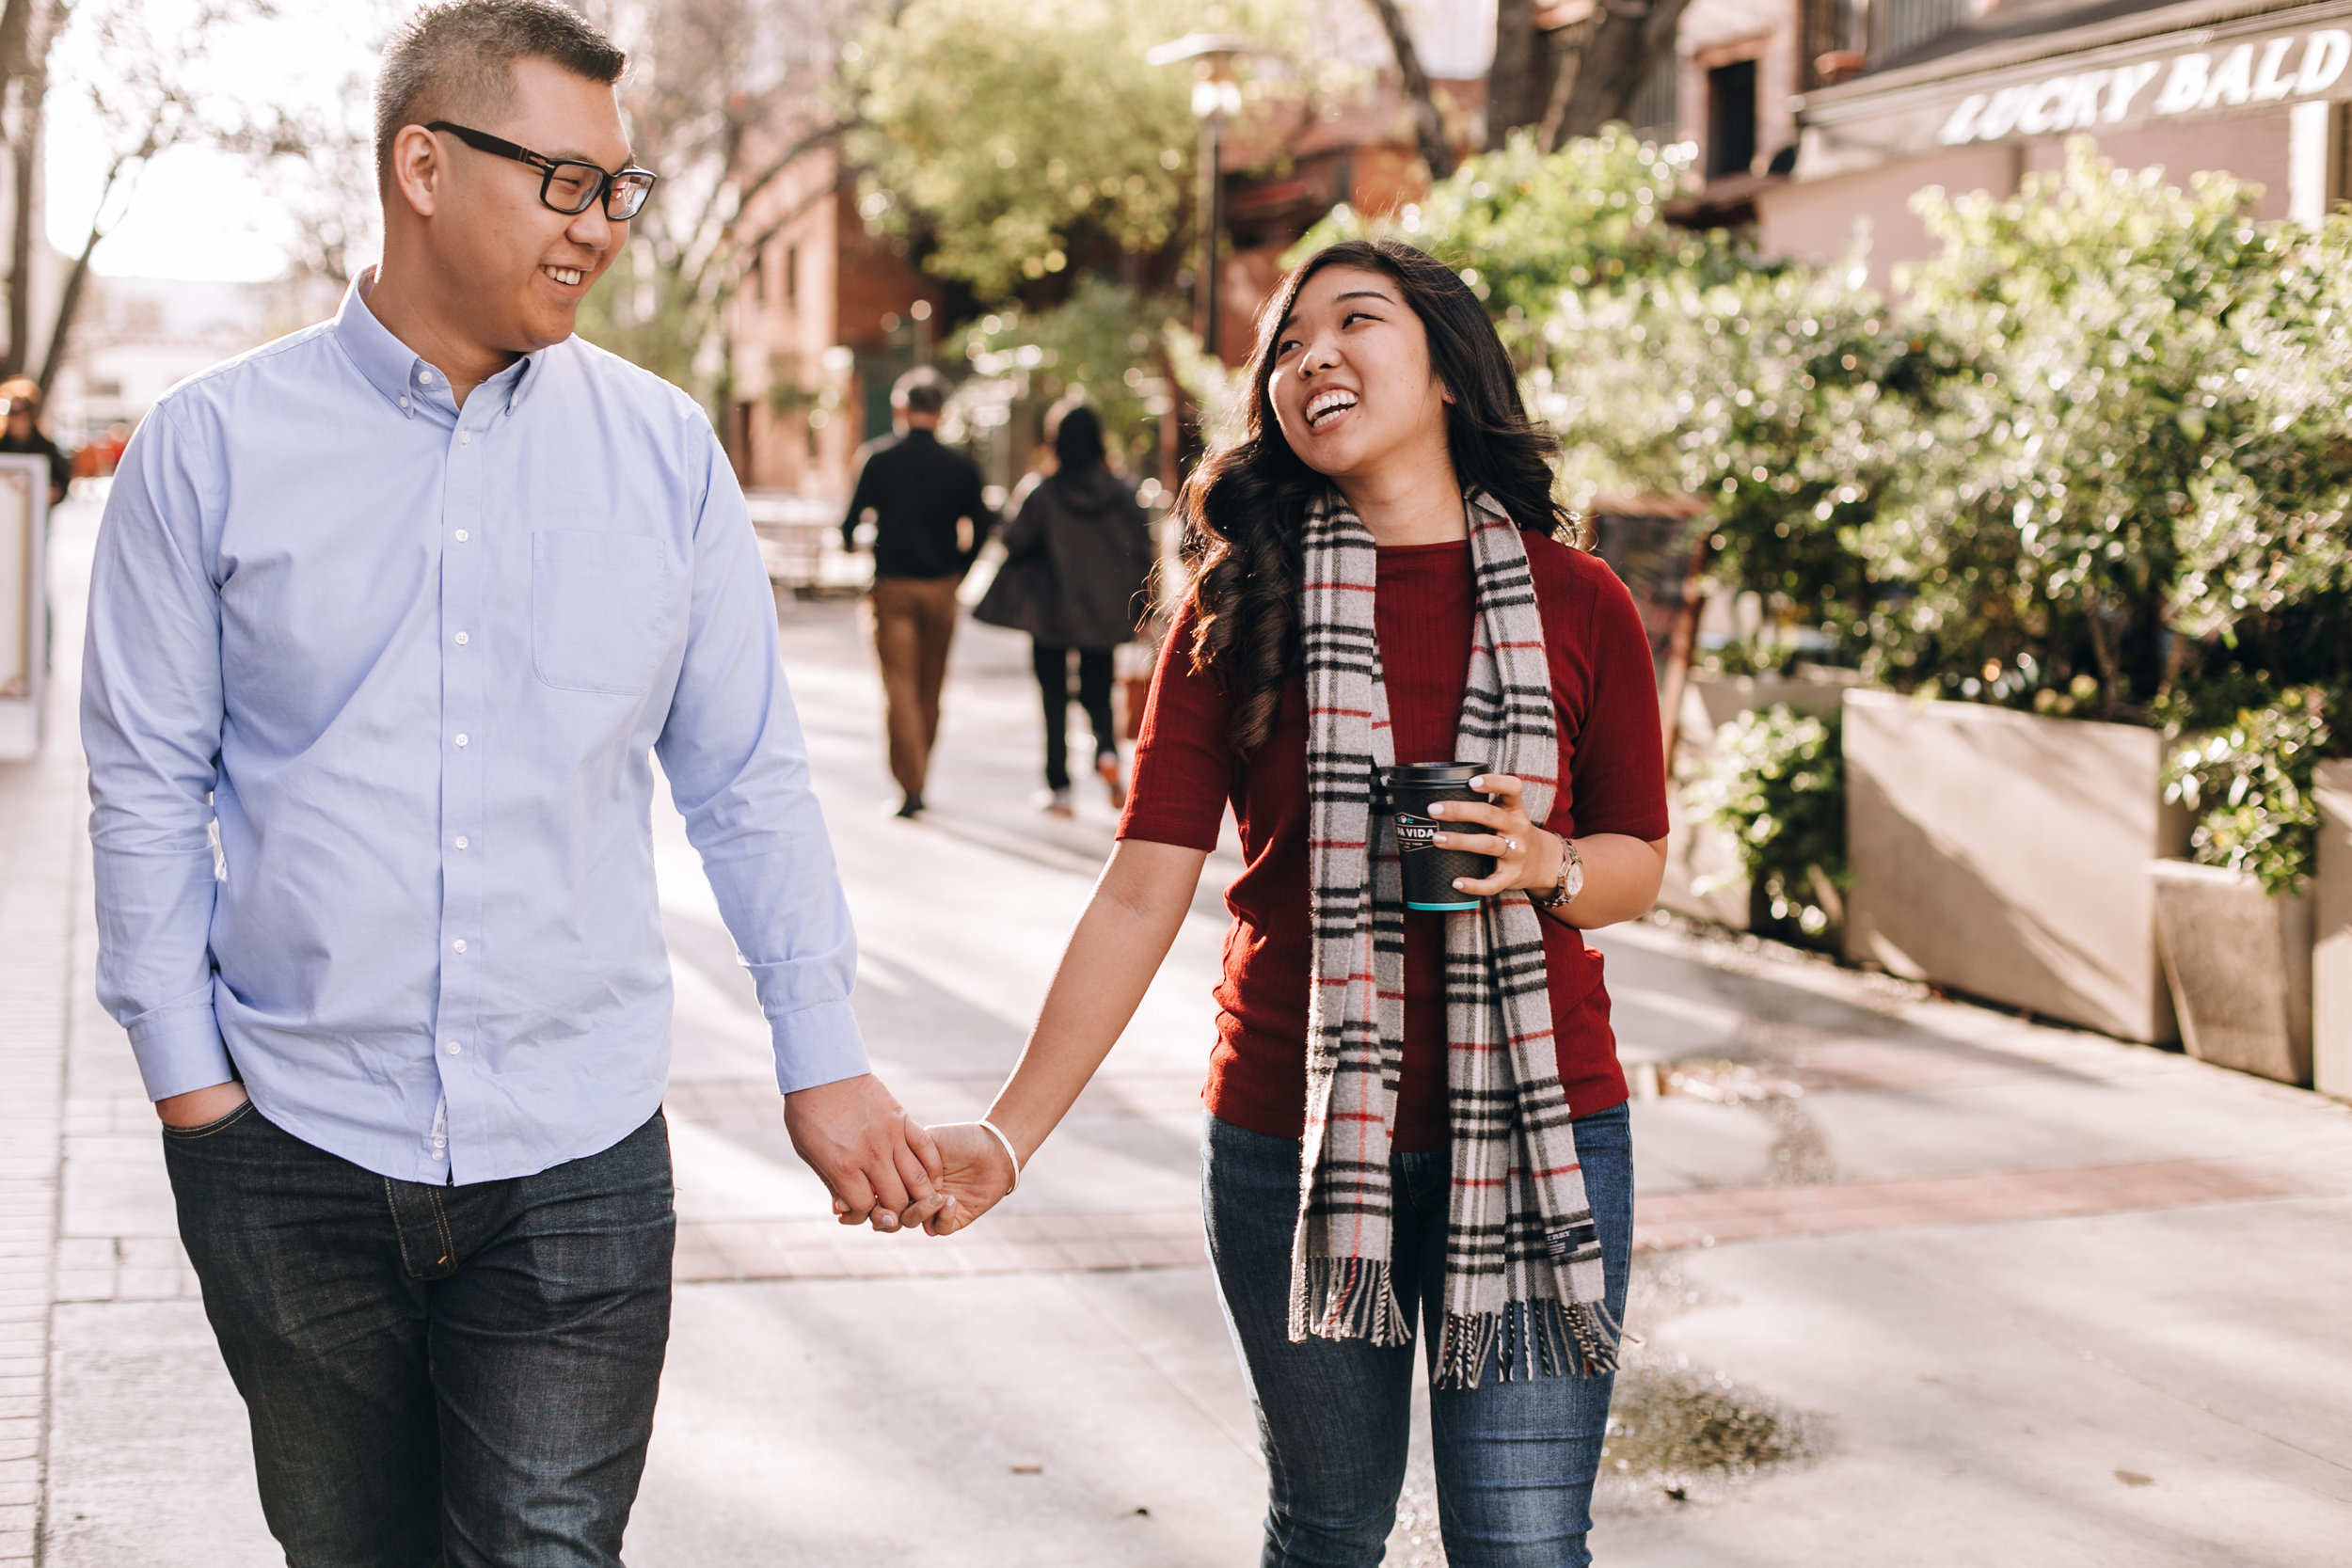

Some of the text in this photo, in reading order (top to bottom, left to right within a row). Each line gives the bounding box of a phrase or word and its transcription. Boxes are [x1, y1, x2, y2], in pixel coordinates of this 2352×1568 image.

[1938, 29, 2351, 145] LUCKY BALD
[1406, 828, 1434, 838] VIDA
